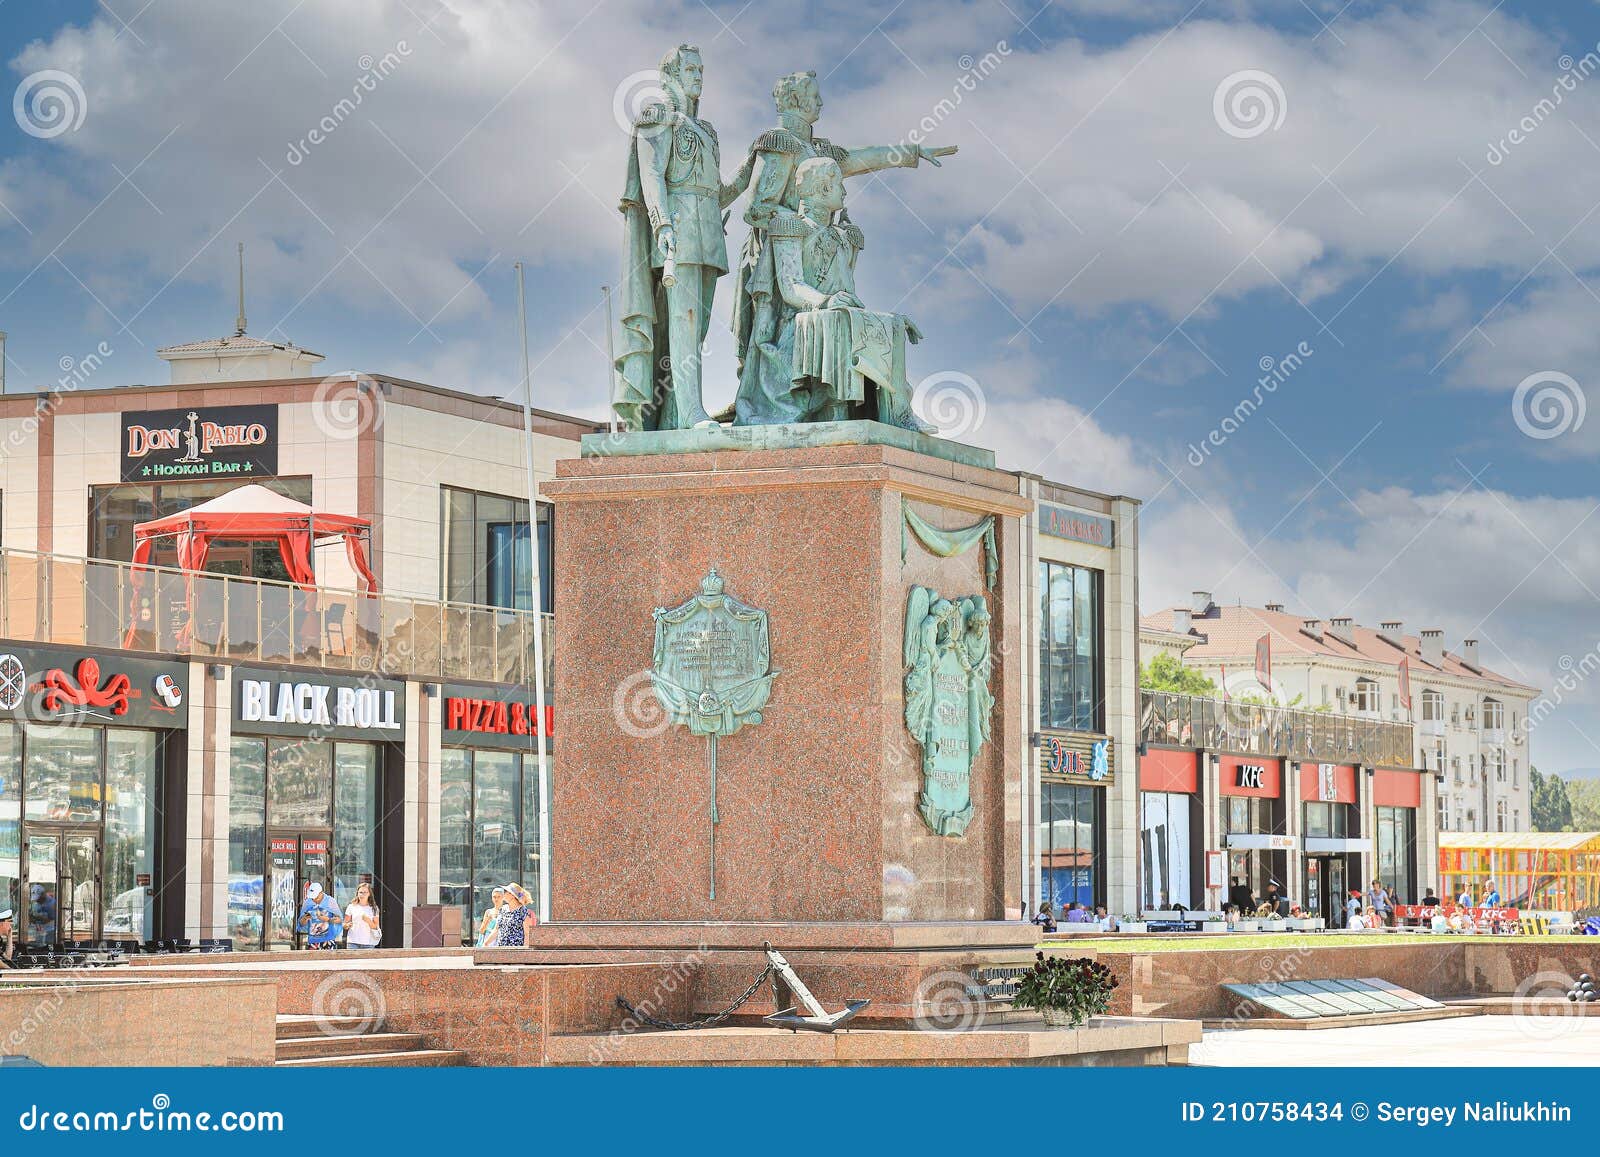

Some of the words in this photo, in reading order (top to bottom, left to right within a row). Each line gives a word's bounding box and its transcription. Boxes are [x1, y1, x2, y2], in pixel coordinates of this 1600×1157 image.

[127, 425, 181, 457] DON
[200, 421, 267, 453] PABLO
[153, 464, 208, 476] HOOKAH
[212, 461, 240, 473] BAR
[242, 679, 331, 725] BLACK
[336, 686, 400, 730] ROLL
[447, 697, 509, 734] PIZZA
[511, 701, 528, 735] &
[1051, 737, 1085, 774] Эль
[1239, 764, 1264, 788] KFC
[1481, 909, 1508, 919] KFC
